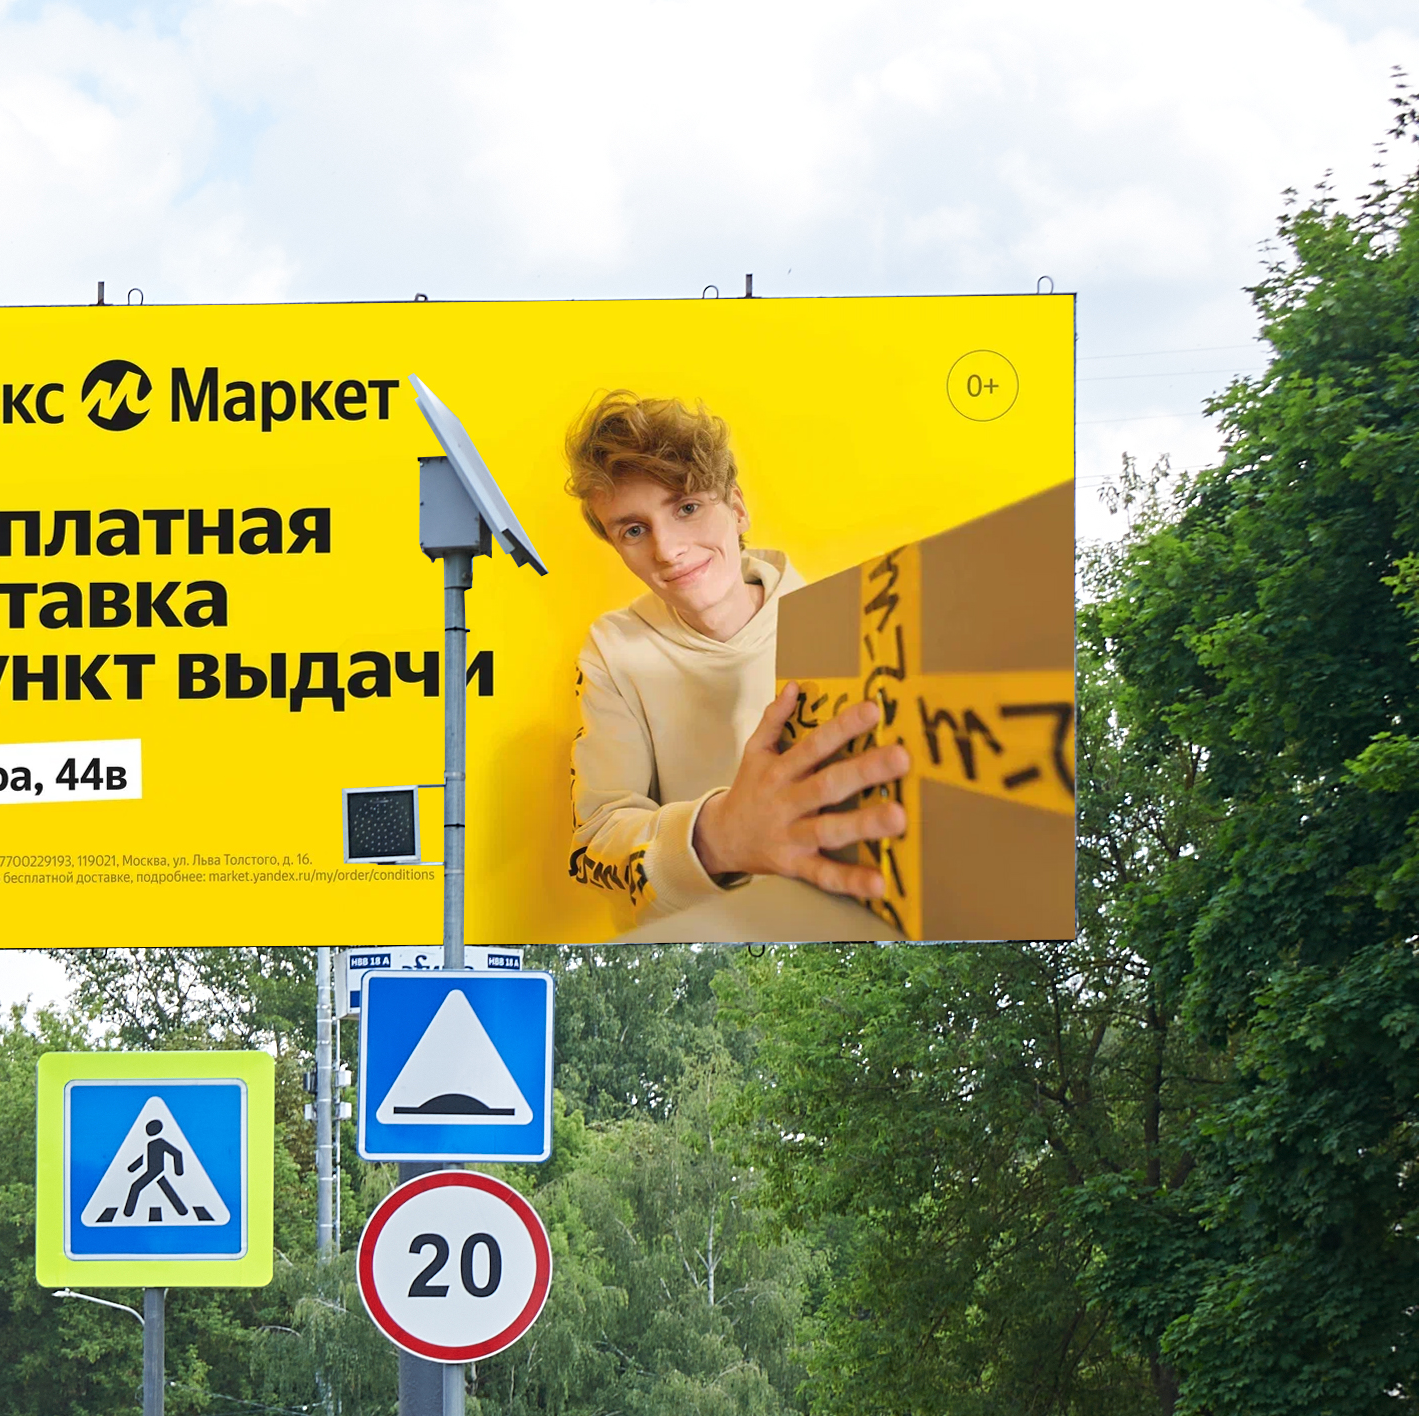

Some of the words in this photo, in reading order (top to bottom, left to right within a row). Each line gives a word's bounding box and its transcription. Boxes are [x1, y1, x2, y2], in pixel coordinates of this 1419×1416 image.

[171, 366, 400, 433] Маркет
[967, 374, 999, 398] 0+
[178, 650, 494, 713] выдачи
[55, 757, 127, 791] 44в
[3, 871, 74, 884] бесплатной
[76, 873, 134, 885] доставке,
[136, 870, 206, 885] подробнее:
[208, 868, 436, 885] market.yandex.ru/my/order/conditions
[77, 854, 120, 868] 119021,
[122, 854, 170, 867] Москва,
[172, 856, 190, 868] ул.
[192, 853, 221, 866] Льва
[223, 853, 280, 866] Толстого,
[282, 855, 294, 867] д.
[296, 853, 313, 865] 16.
[407, 1232, 502, 1298] 20
